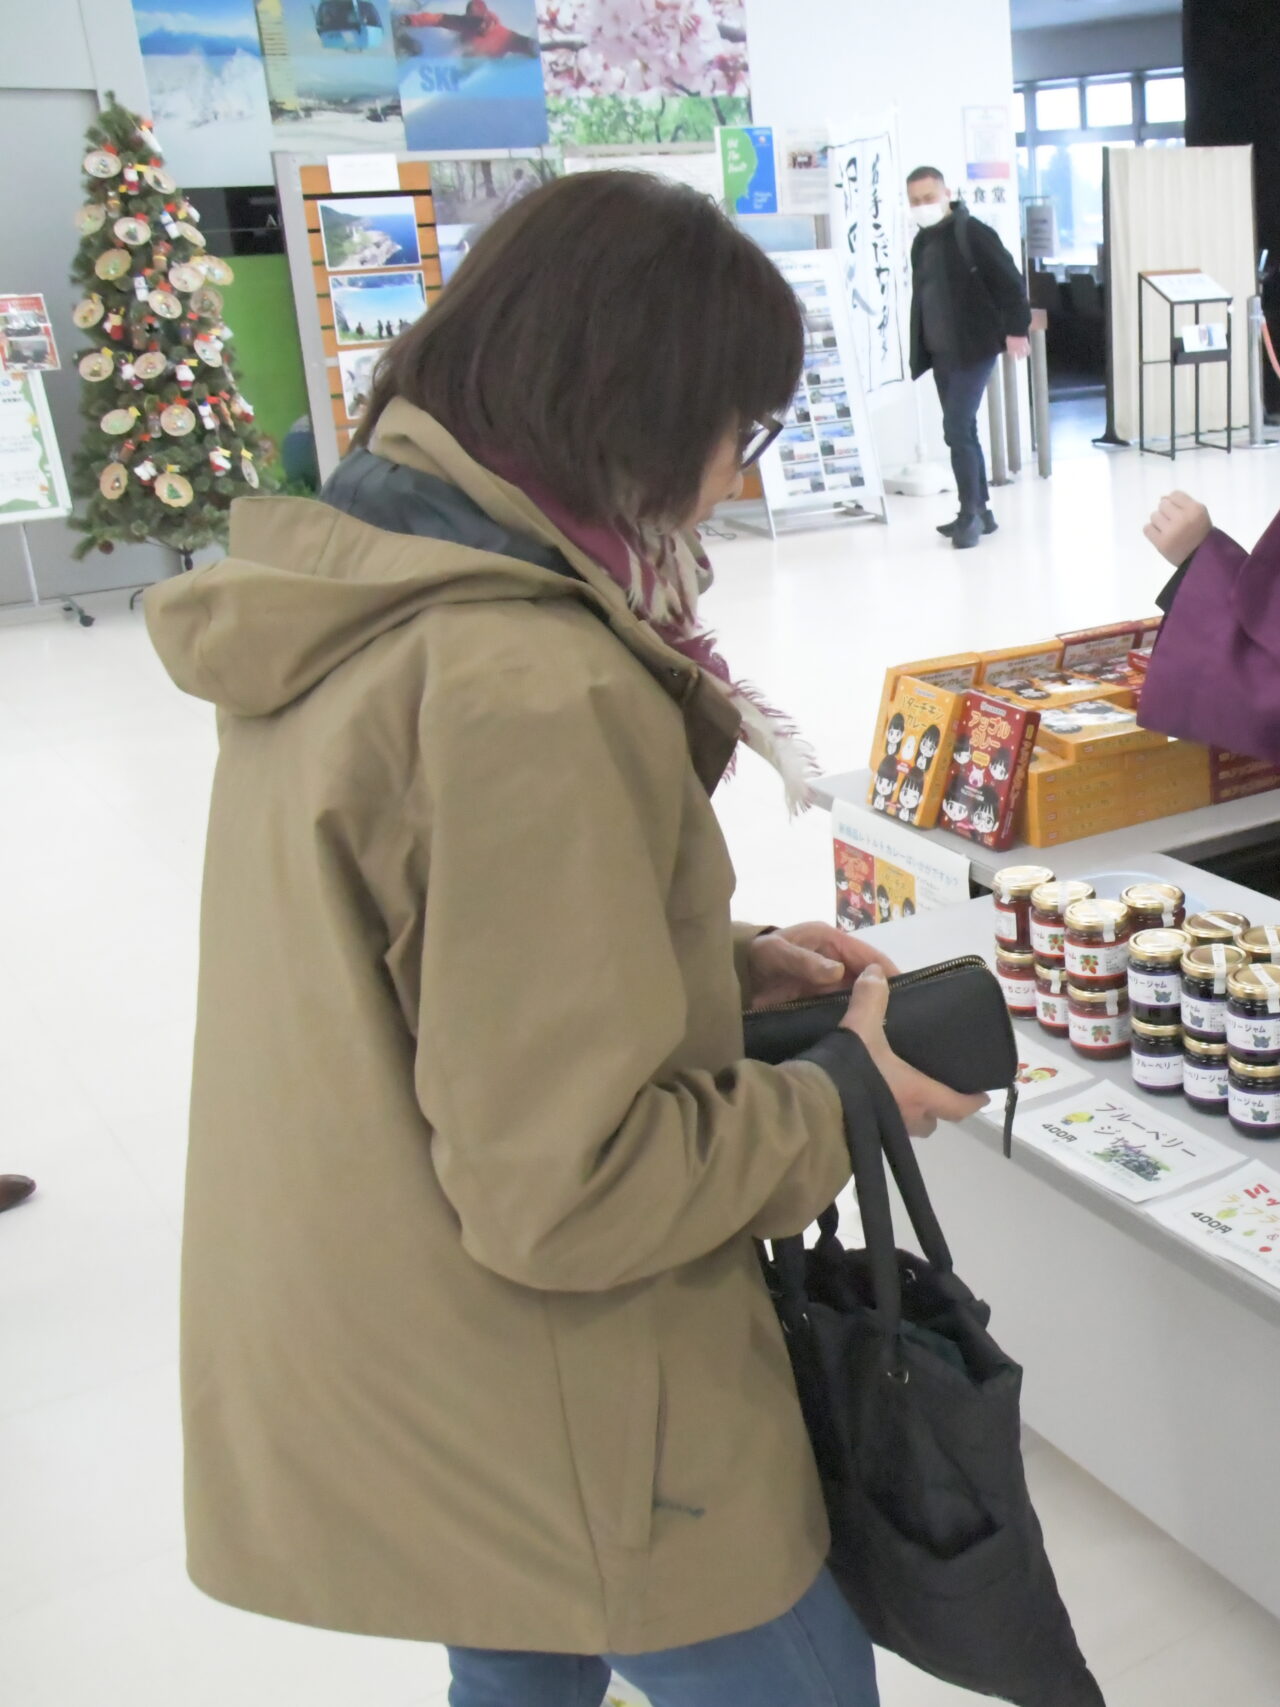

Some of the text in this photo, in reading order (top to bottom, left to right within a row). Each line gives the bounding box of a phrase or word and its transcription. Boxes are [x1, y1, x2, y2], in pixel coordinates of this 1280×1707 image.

[968, 709, 1011, 739] アップル
[969, 727, 1001, 749] カレー
[1041, 1121, 1078, 1143] 400円
[1093, 1124, 1148, 1156] ジャム
[1094, 1101, 1197, 1158] ブルーベリー
[1190, 1210, 1233, 1235] 400円
